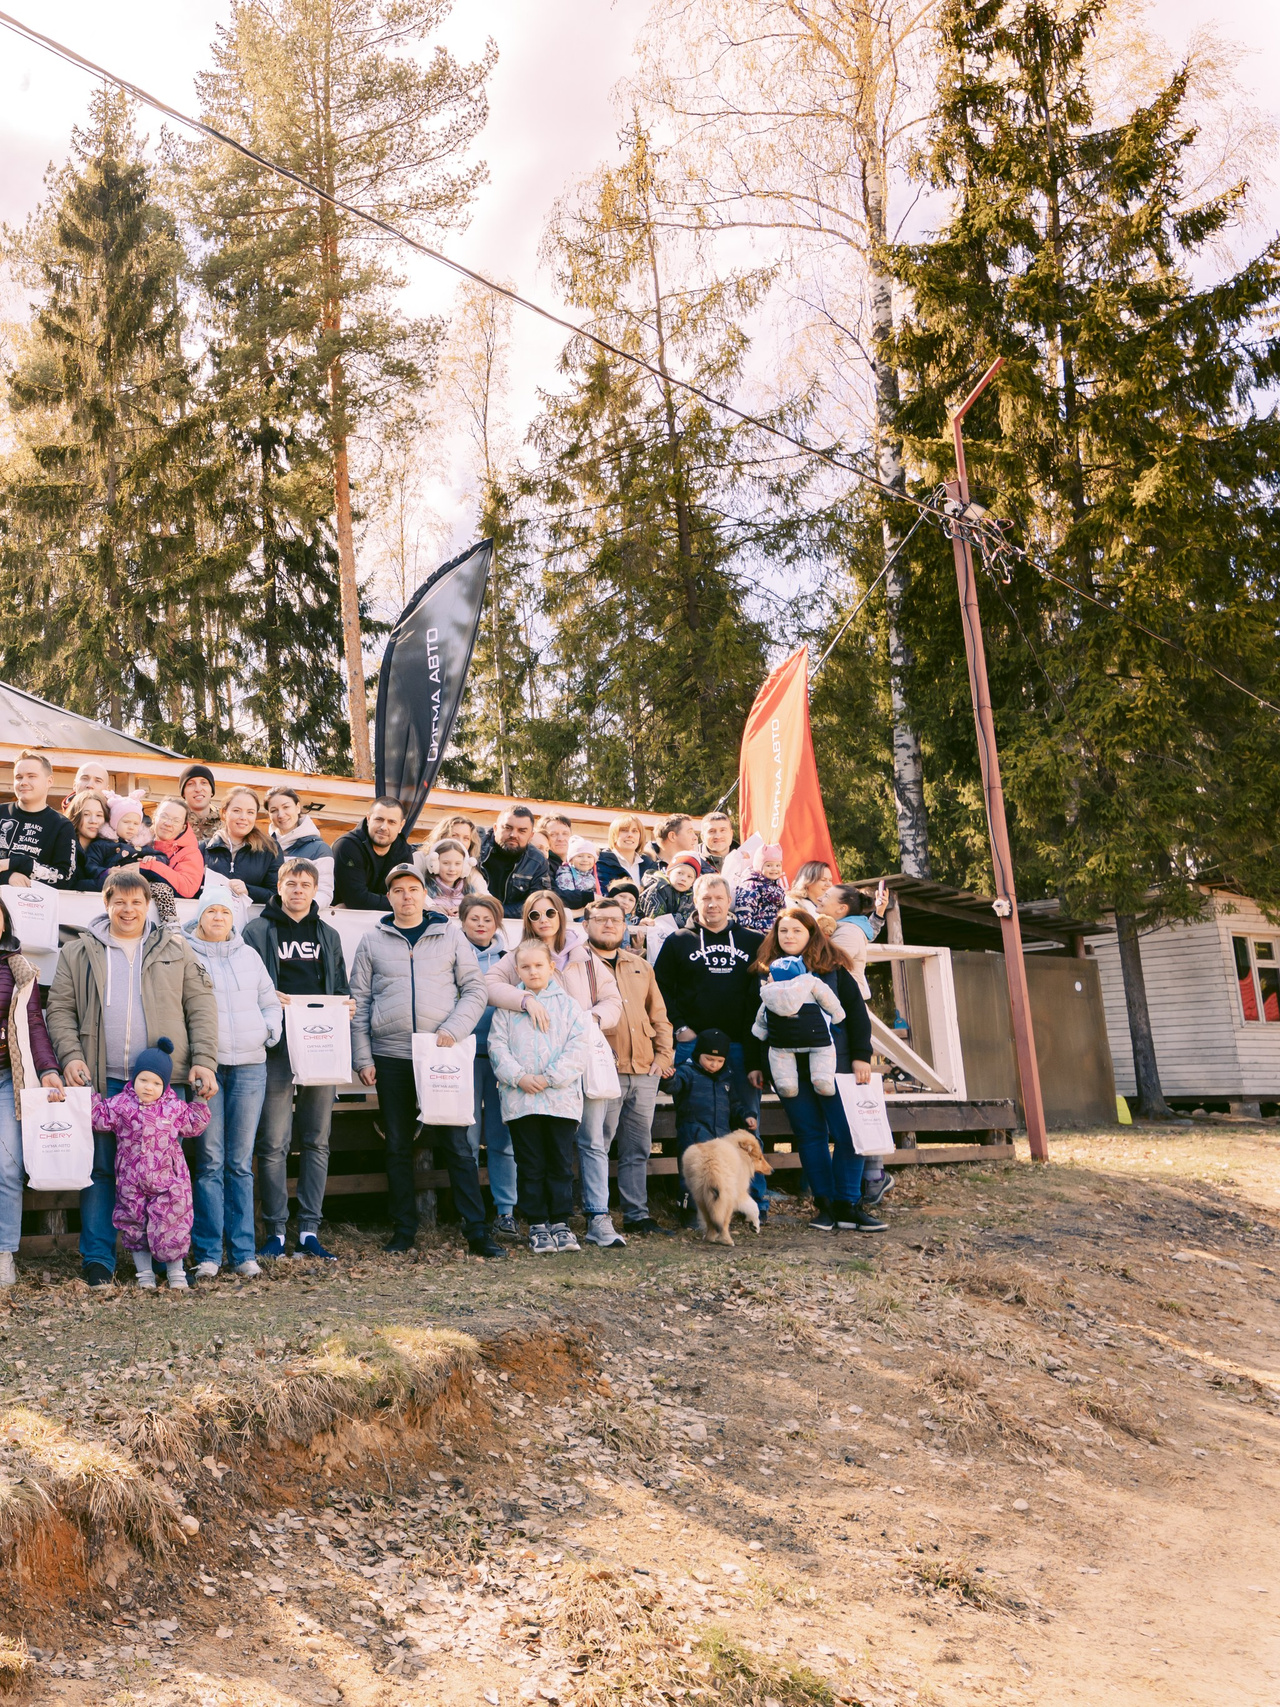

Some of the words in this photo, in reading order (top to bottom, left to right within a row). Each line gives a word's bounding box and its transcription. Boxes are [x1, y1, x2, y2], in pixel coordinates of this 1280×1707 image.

[426, 627, 441, 684] АВТО
[771, 718, 782, 764] АВТО
[688, 944, 750, 962] CALIFORNIA
[704, 956, 736, 966] 1995
